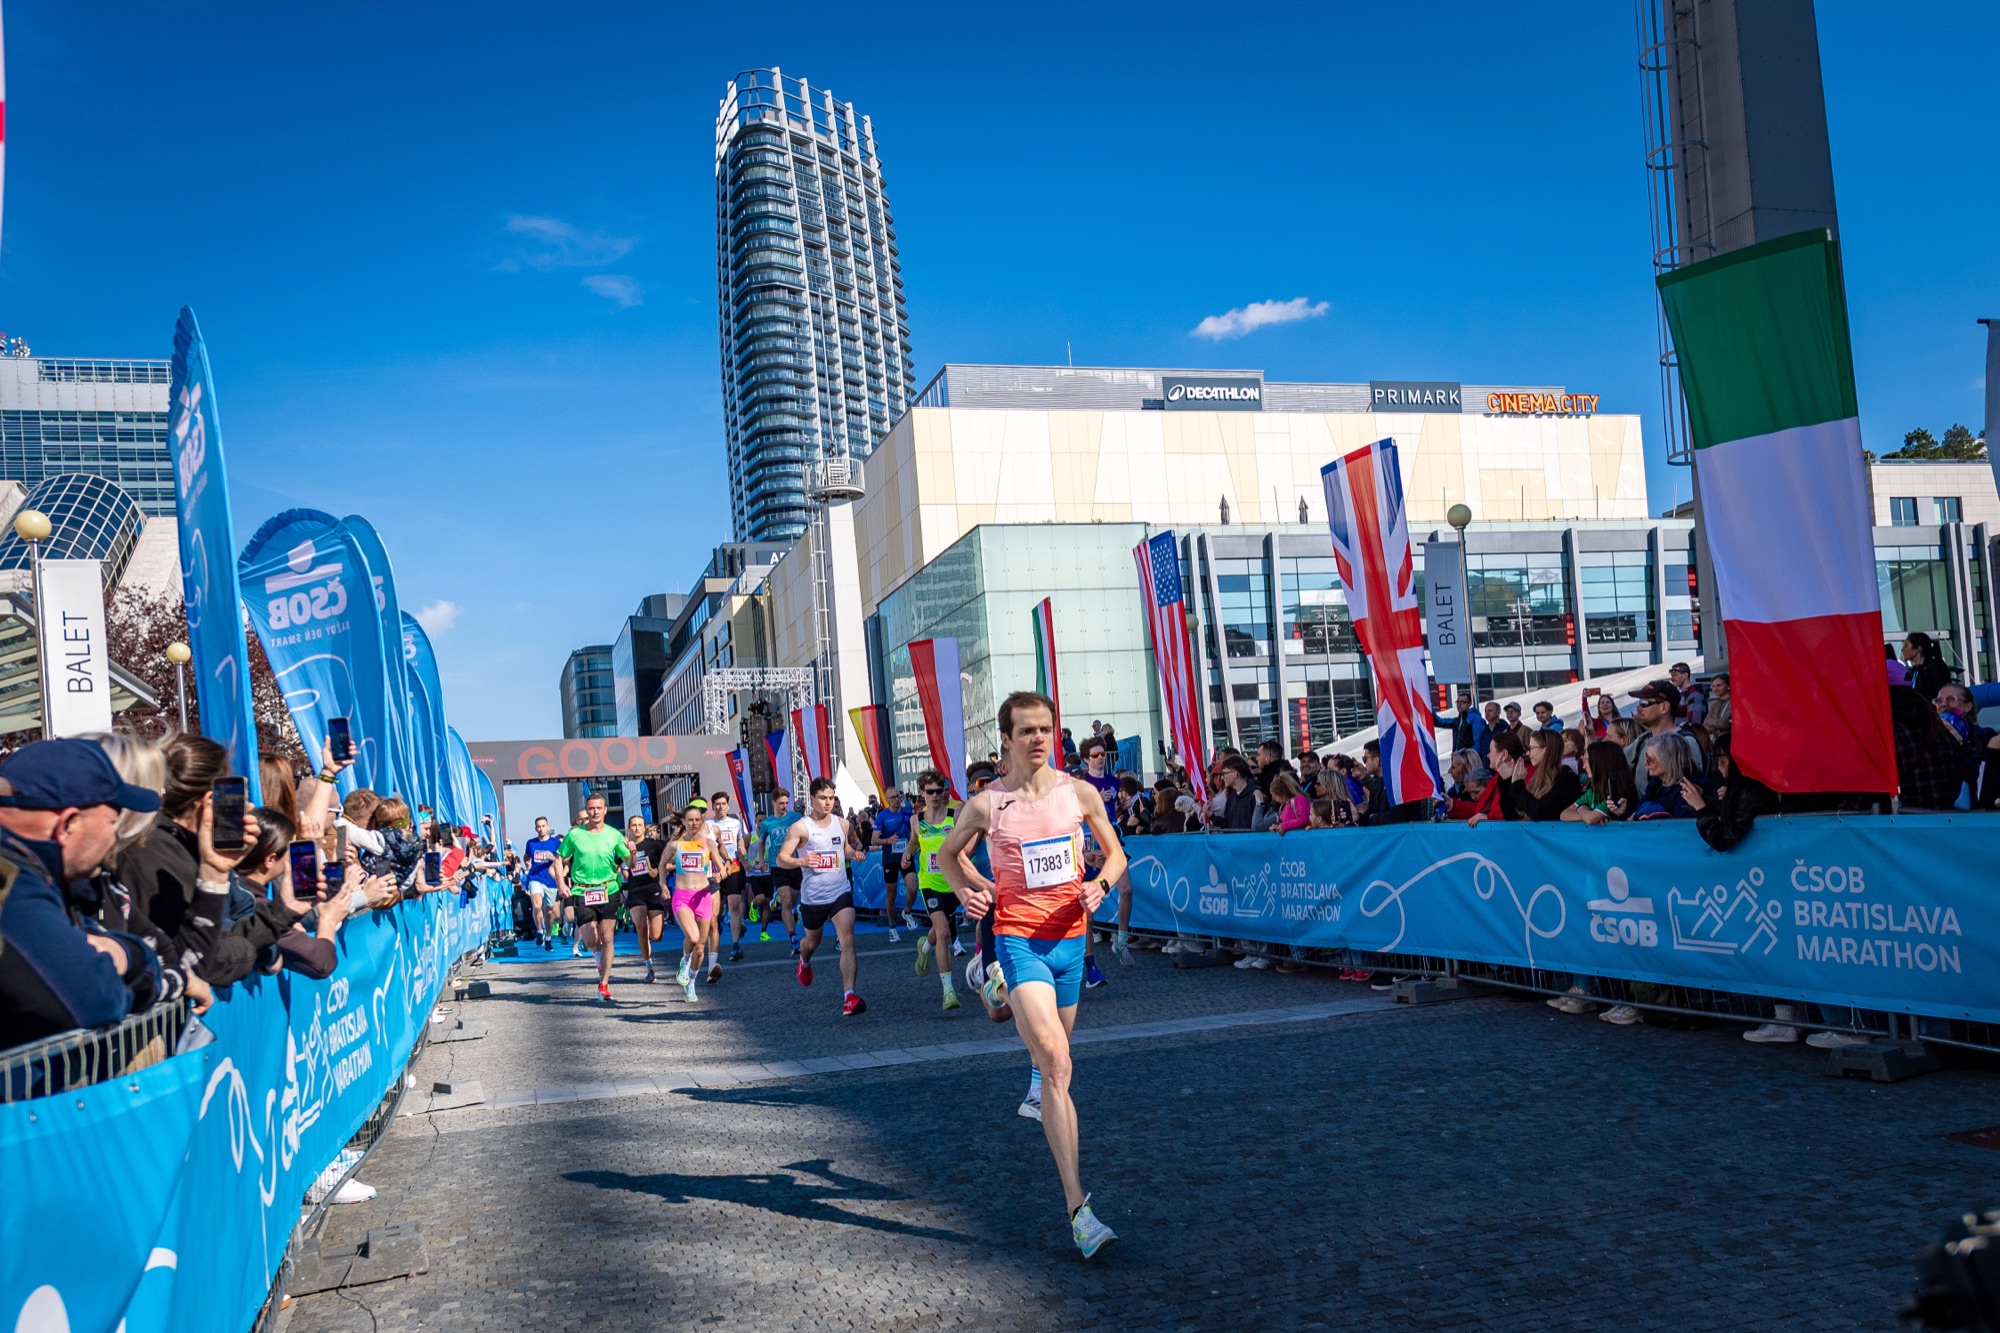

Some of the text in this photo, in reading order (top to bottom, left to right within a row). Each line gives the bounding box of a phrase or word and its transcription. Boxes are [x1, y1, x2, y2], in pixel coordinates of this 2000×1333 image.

[1186, 386, 1260, 400] DECATHLON
[1374, 389, 1460, 404] PRIMARK
[1487, 392, 1599, 413] CINEMA CITY
[1435, 582, 1456, 646] BALET
[63, 611, 93, 692] BALET
[665, 764, 693, 772] 0:00:06
[1028, 854, 1063, 875] 17383
[1280, 857, 1306, 878] ČSOB
[1790, 859, 1865, 893] ČSOB
[1281, 882, 1343, 900] BRATISLAVA
[1199, 895, 1229, 916] ČSOB
[1282, 903, 1342, 922] MARATHON
[1589, 911, 1659, 947] ČSOB
[1793, 900, 1963, 937] BRATISLAVA
[1796, 934, 1962, 974] MARATHON
